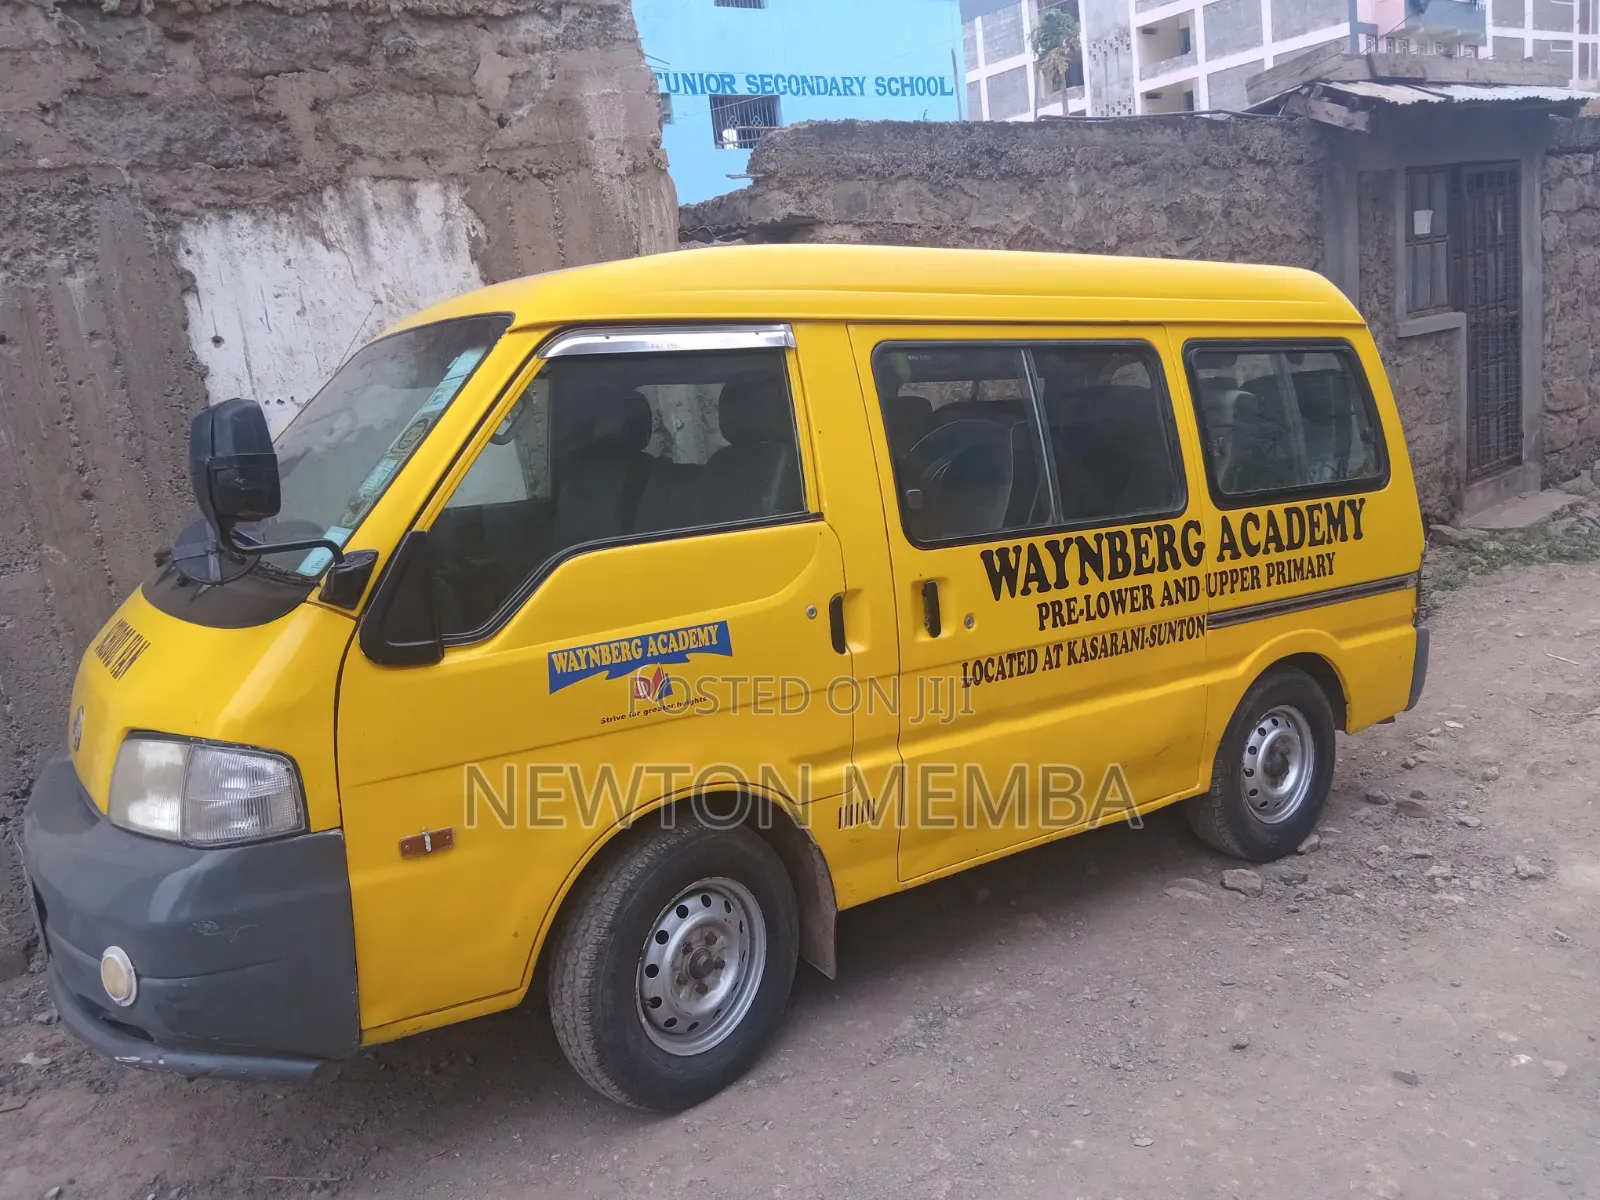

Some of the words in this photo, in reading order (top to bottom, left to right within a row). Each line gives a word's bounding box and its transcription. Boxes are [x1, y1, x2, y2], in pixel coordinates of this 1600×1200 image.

[745, 74, 866, 96] SECONDARY
[875, 76, 954, 97] SCHOOL
[980, 520, 1205, 601] WAYNBERG
[1216, 498, 1366, 563] ACADEMY
[1037, 584, 1155, 631] PRE-LOWER
[1160, 576, 1200, 607] AND
[1205, 563, 1261, 597] UPPER
[1266, 552, 1336, 591] PRIMARY
[551, 639, 643, 674] WAYNBERG
[647, 625, 719, 657] ACADEMY
[962, 648, 1038, 688] LOCATED
[1042, 643, 1063, 671] AT
[1067, 615, 1206, 667] KASARANI-SUNTON
[601, 713, 626, 724] Strive
[643, 704, 675, 716] greater
